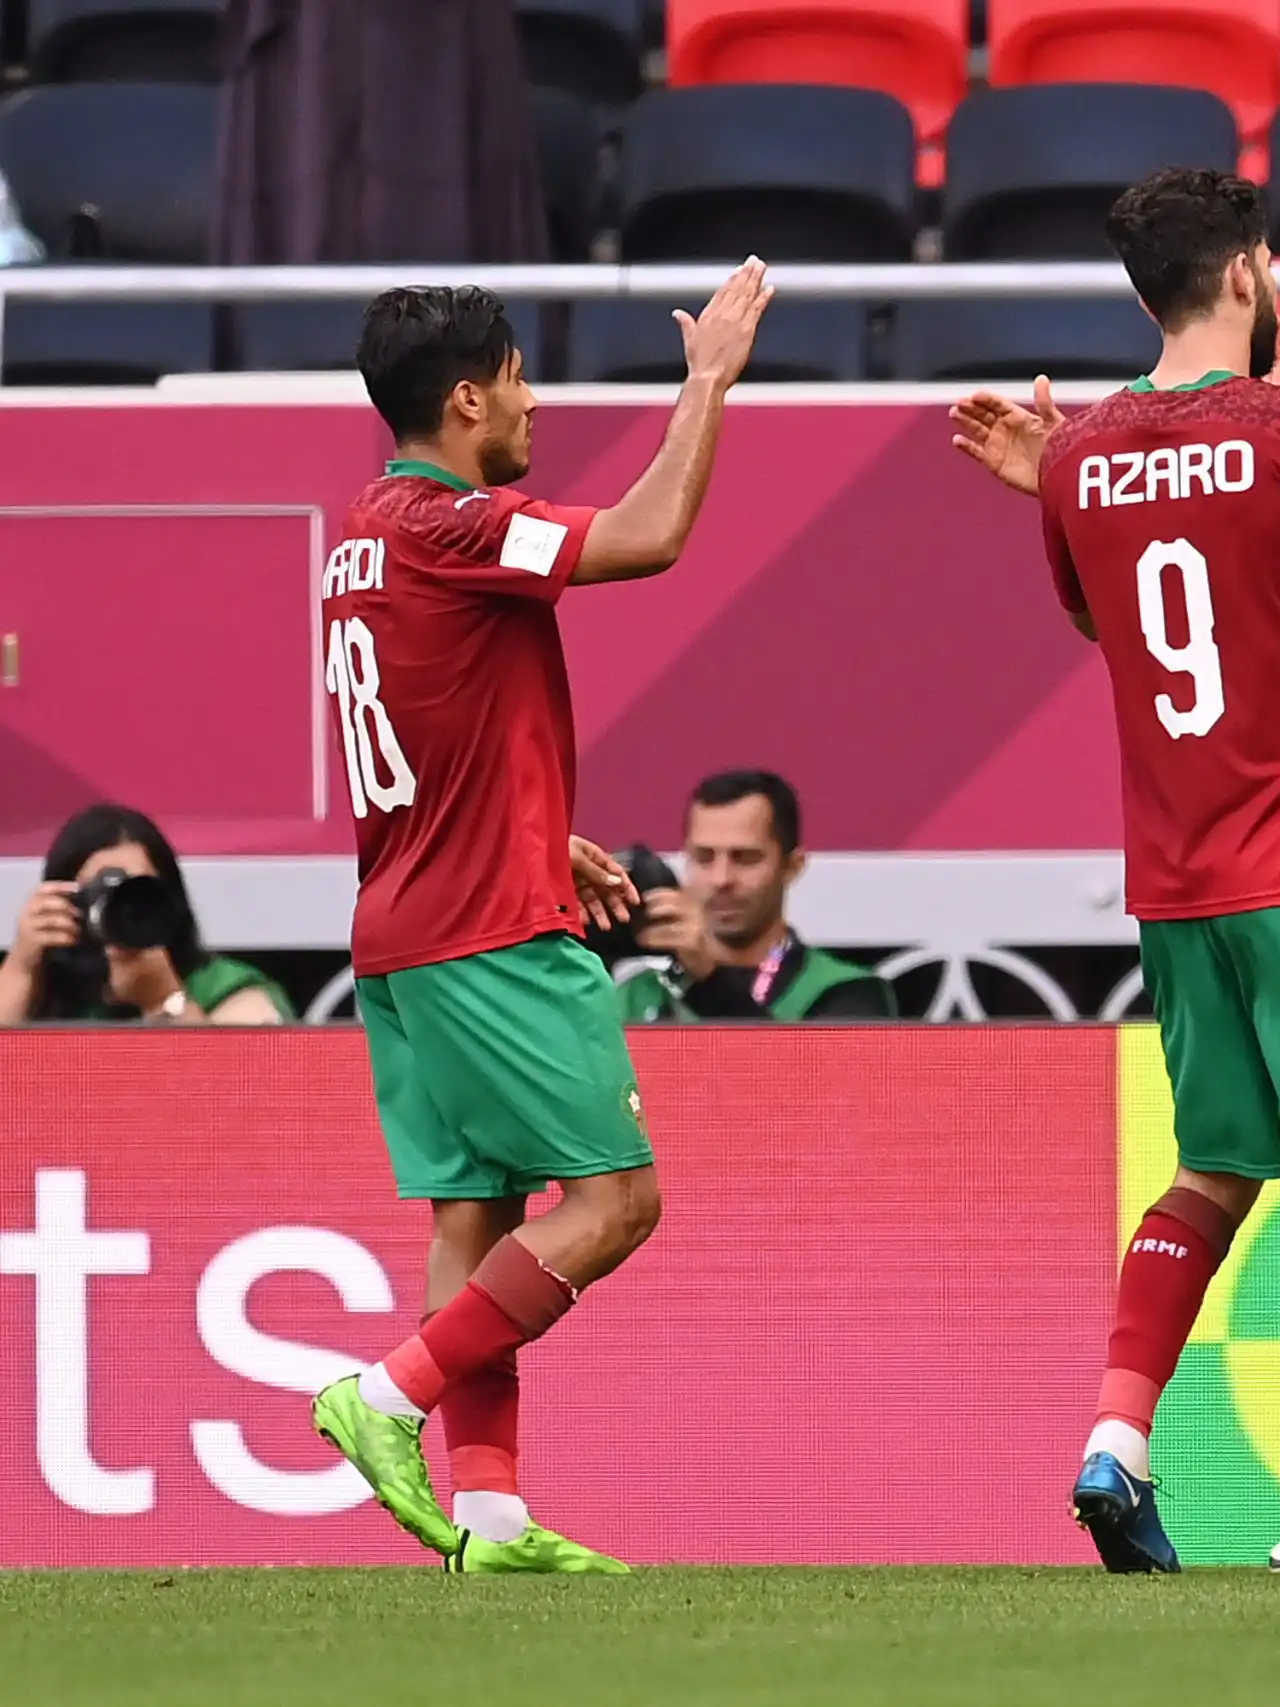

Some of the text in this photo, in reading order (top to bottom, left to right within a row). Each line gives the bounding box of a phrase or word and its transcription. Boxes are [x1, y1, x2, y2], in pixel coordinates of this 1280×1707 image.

[1079, 440, 1254, 509] AZARO
[325, 616, 416, 818] 18
[1136, 538, 1225, 739] 9
[0, 1167, 395, 1516] ts
[1132, 1238, 1188, 1259] FRMF
